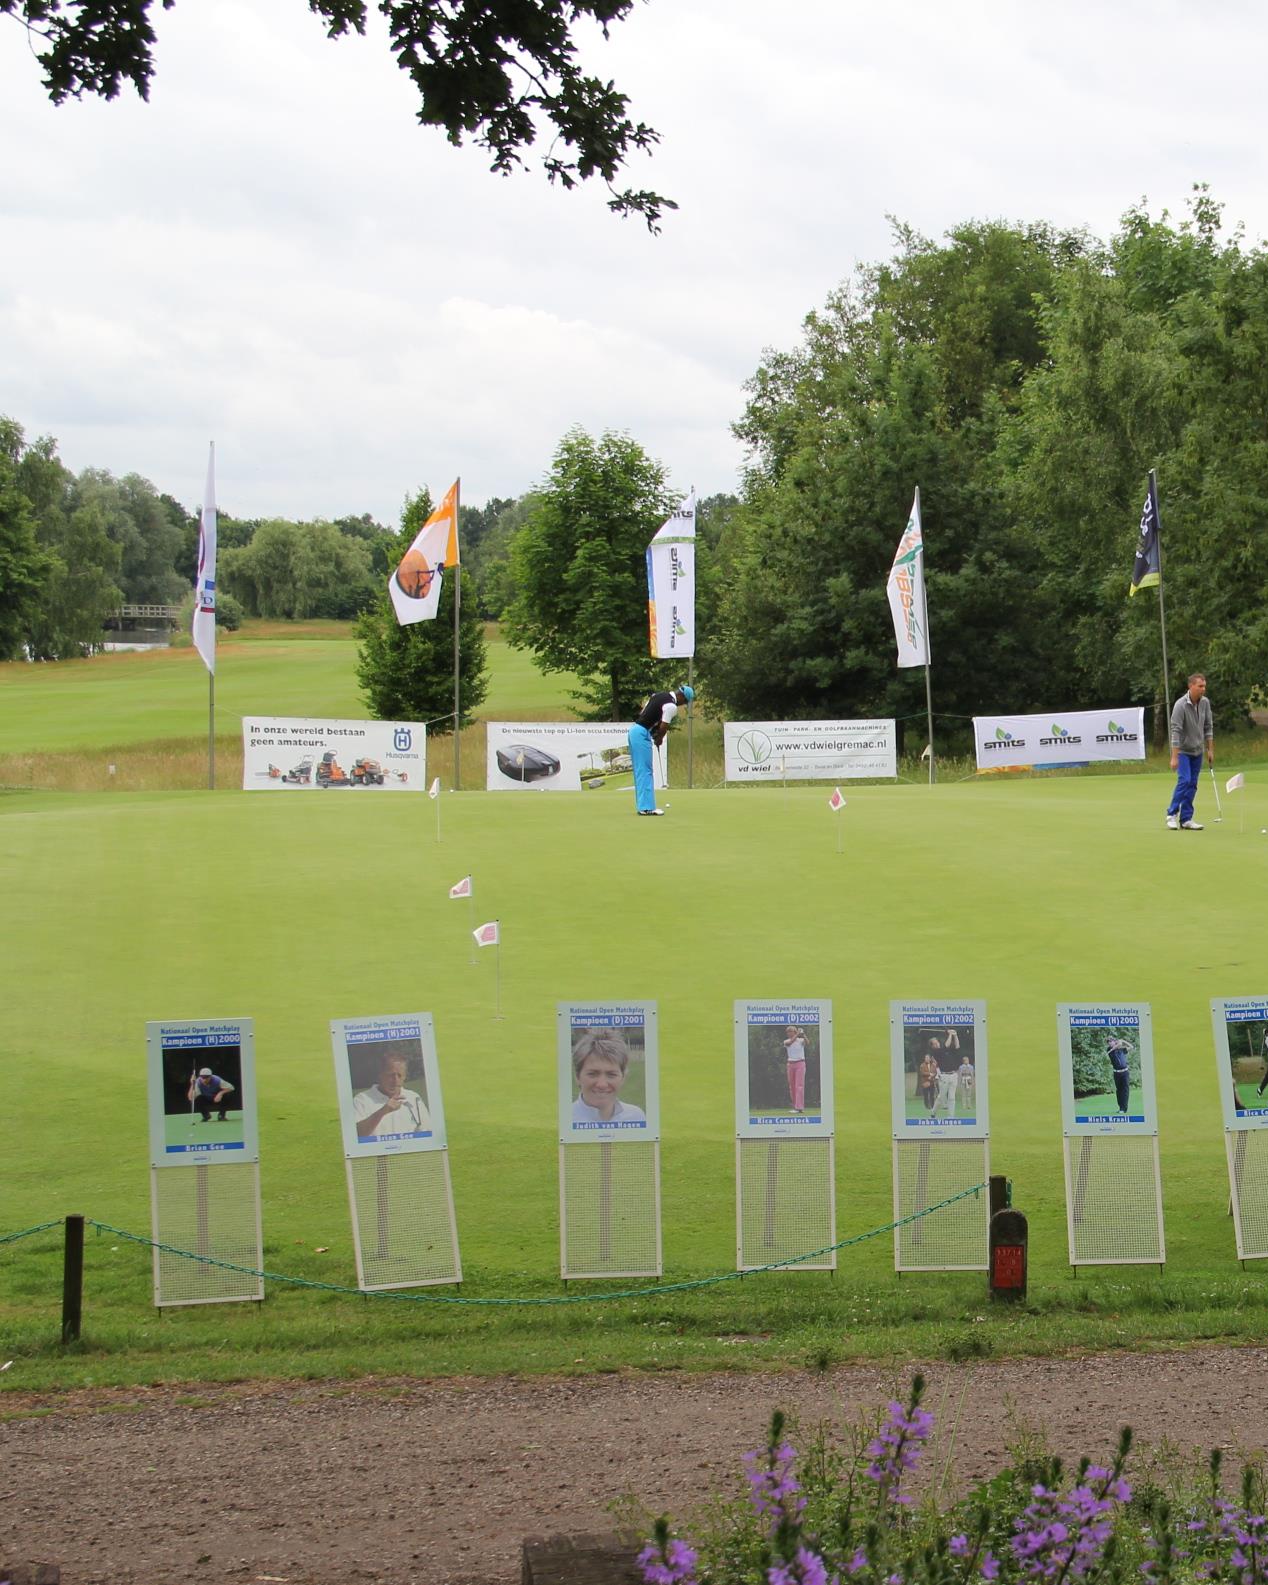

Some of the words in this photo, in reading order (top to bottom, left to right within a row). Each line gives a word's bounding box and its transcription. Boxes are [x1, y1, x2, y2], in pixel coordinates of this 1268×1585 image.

[327, 728, 365, 736] bestaan
[1040, 736, 1081, 745] smits
[1096, 734, 1137, 742] smits
[251, 739, 274, 747] geen
[776, 740, 886, 751] www.vdwielgremac.nl
[984, 739, 1025, 749] smits
[749, 1014, 784, 1023] Kampioen
[1226, 1011, 1260, 1019] Kampioen
[572, 1016, 608, 1026] Kampioen
[904, 1016, 940, 1024] Kampioen
[1070, 1017, 1105, 1025] Kampioen
[346, 1032, 384, 1041] Kampioen
[163, 1037, 202, 1046] Kampioen
